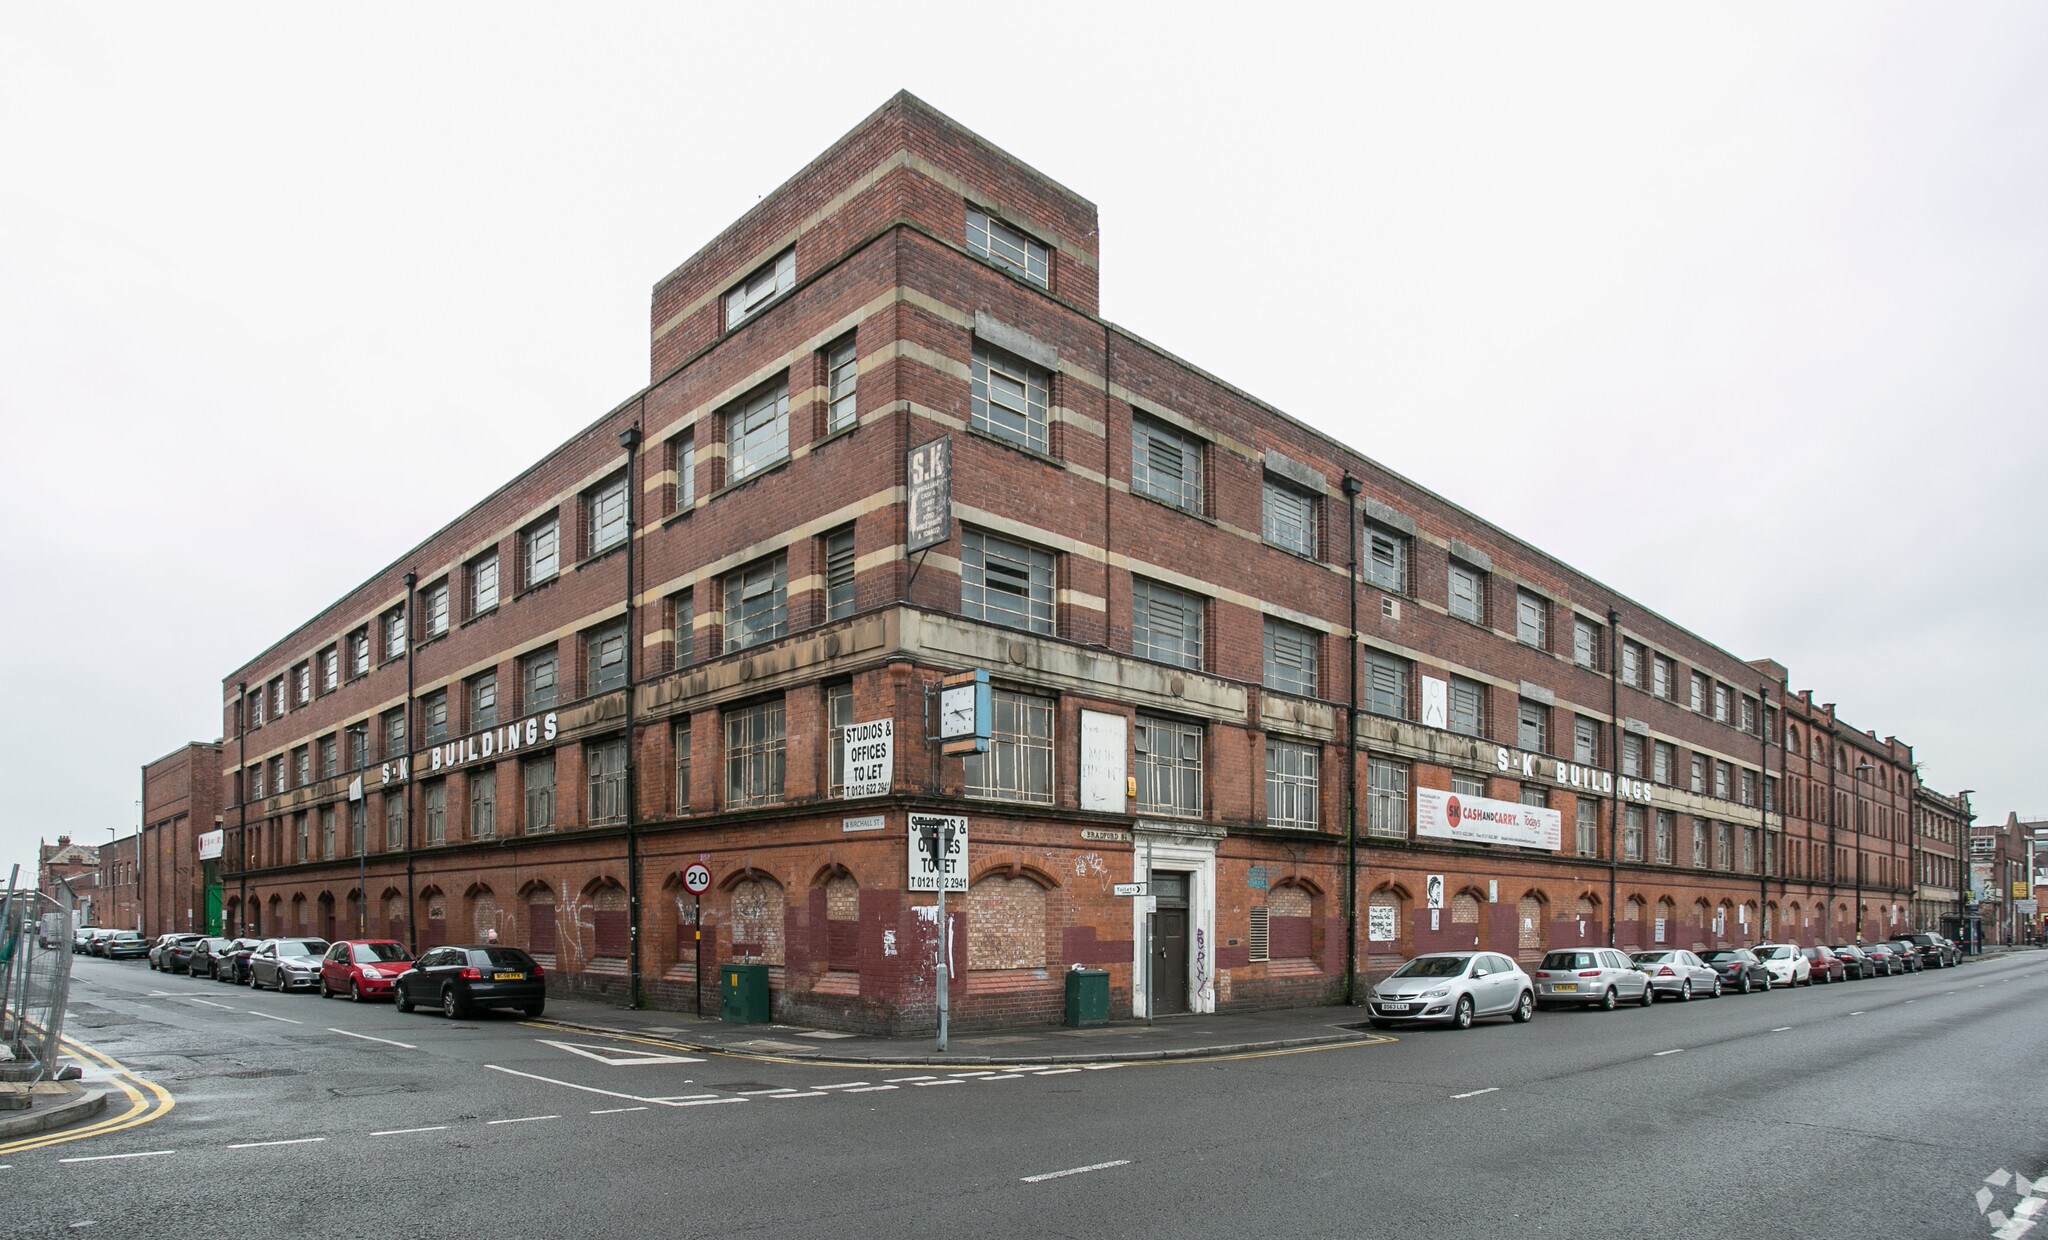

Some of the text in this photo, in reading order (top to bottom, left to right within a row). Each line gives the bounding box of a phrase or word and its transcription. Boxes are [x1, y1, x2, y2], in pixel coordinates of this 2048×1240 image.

[913, 444, 942, 484] S.K
[846, 721, 892, 743] STUDIOS &
[432, 712, 557, 771] BUILDINGS
[851, 742, 886, 762] OFFICES
[854, 763, 883, 782] TO LET
[846, 786, 850, 797] T
[851, 783, 865, 797] 0121
[866, 782, 876, 795] 622
[1449, 805, 1460, 818] SK
[850, 820, 872, 828] BIRCHALL
[960, 819, 966, 834] &
[1087, 831, 1119, 840] BRADFORD
[940, 859, 956, 873] ET
[688, 872, 708, 885] 20
[911, 877, 915, 888] T
[917, 877, 934, 888] 0121
[951, 878, 967, 888] 2941
